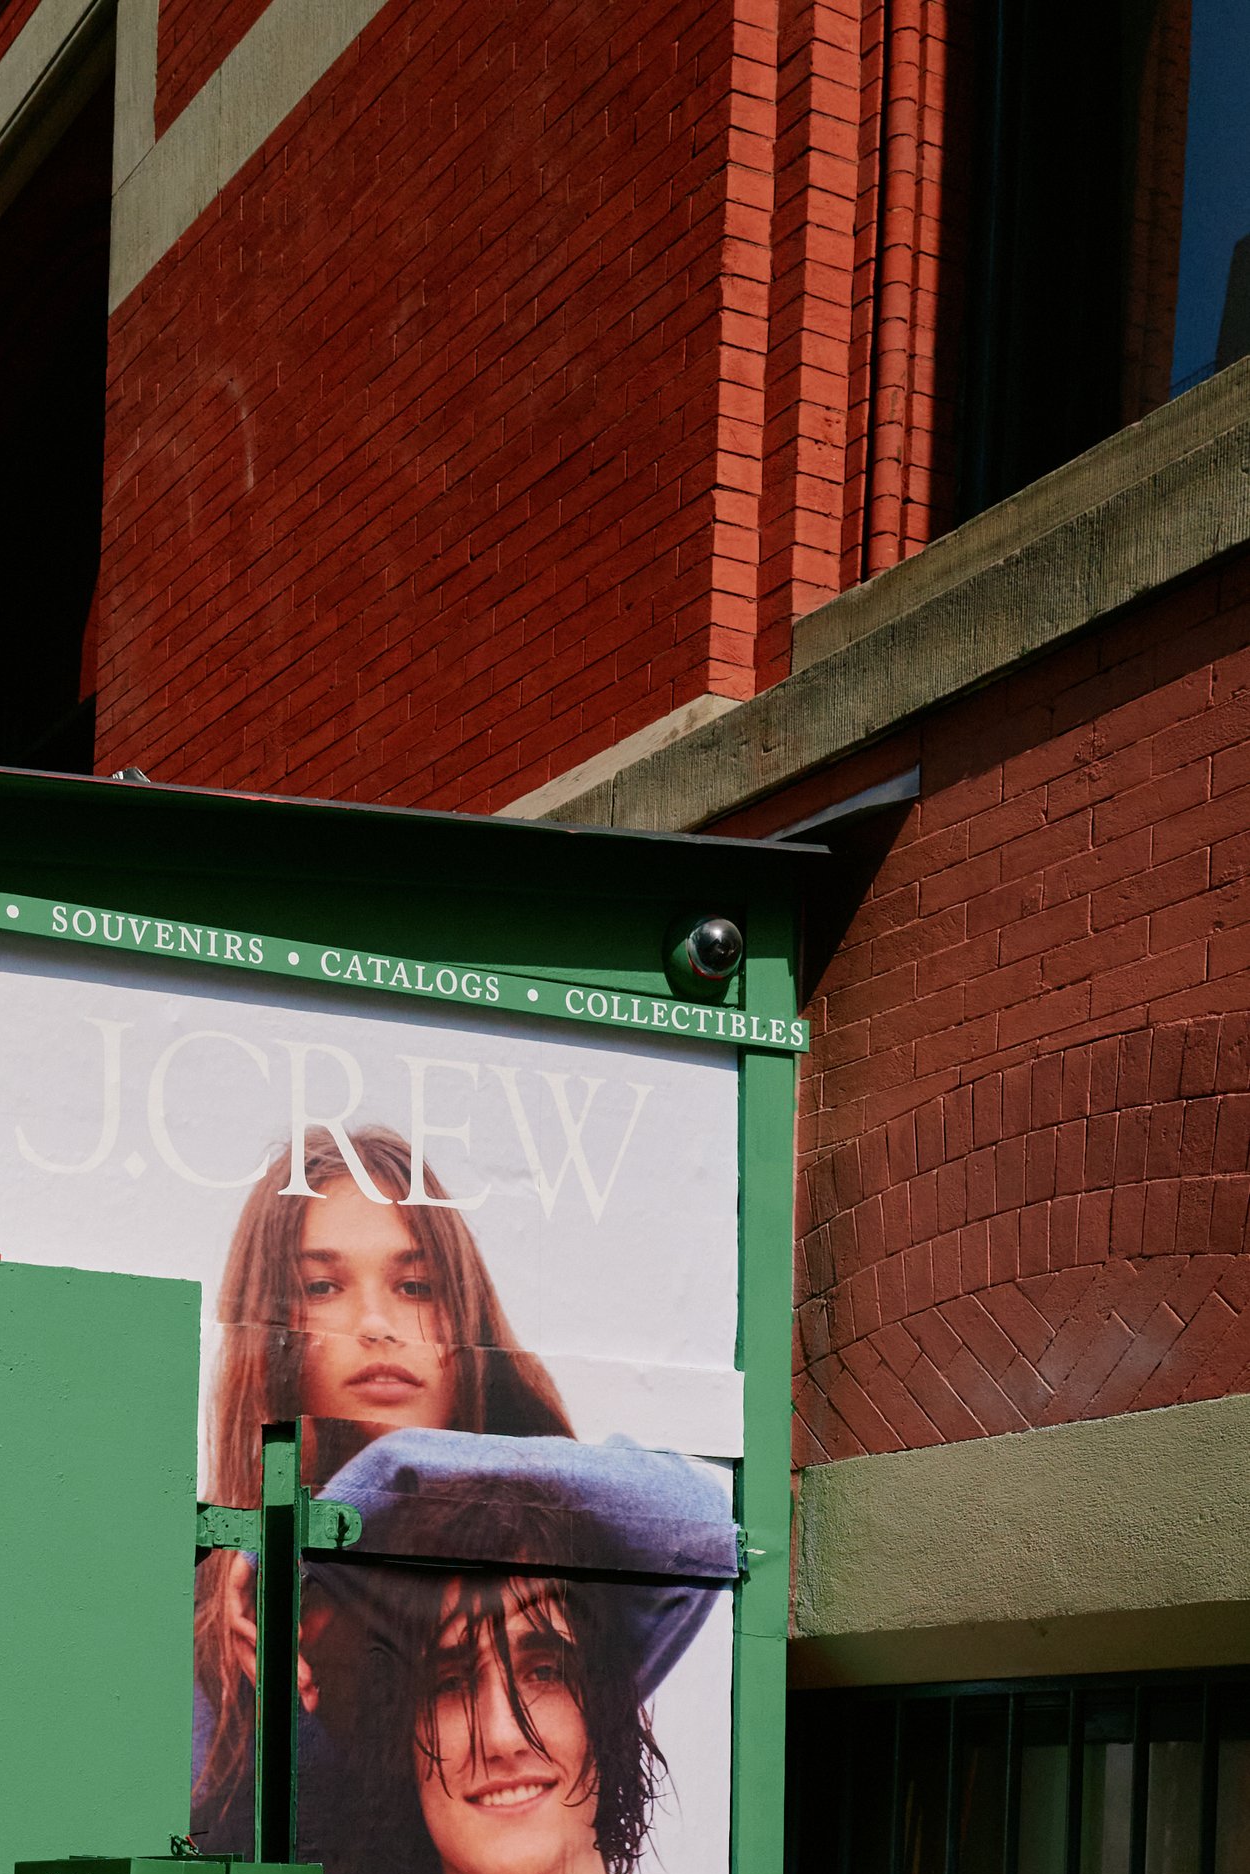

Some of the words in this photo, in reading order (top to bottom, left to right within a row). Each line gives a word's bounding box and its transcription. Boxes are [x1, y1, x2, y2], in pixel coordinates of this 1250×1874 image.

[51, 905, 265, 965] SOUVENIRS
[320, 950, 500, 1003] CATALOGS
[564, 989, 806, 1048] COLLECTIBLES
[16, 1018, 653, 1226] J.CREW
